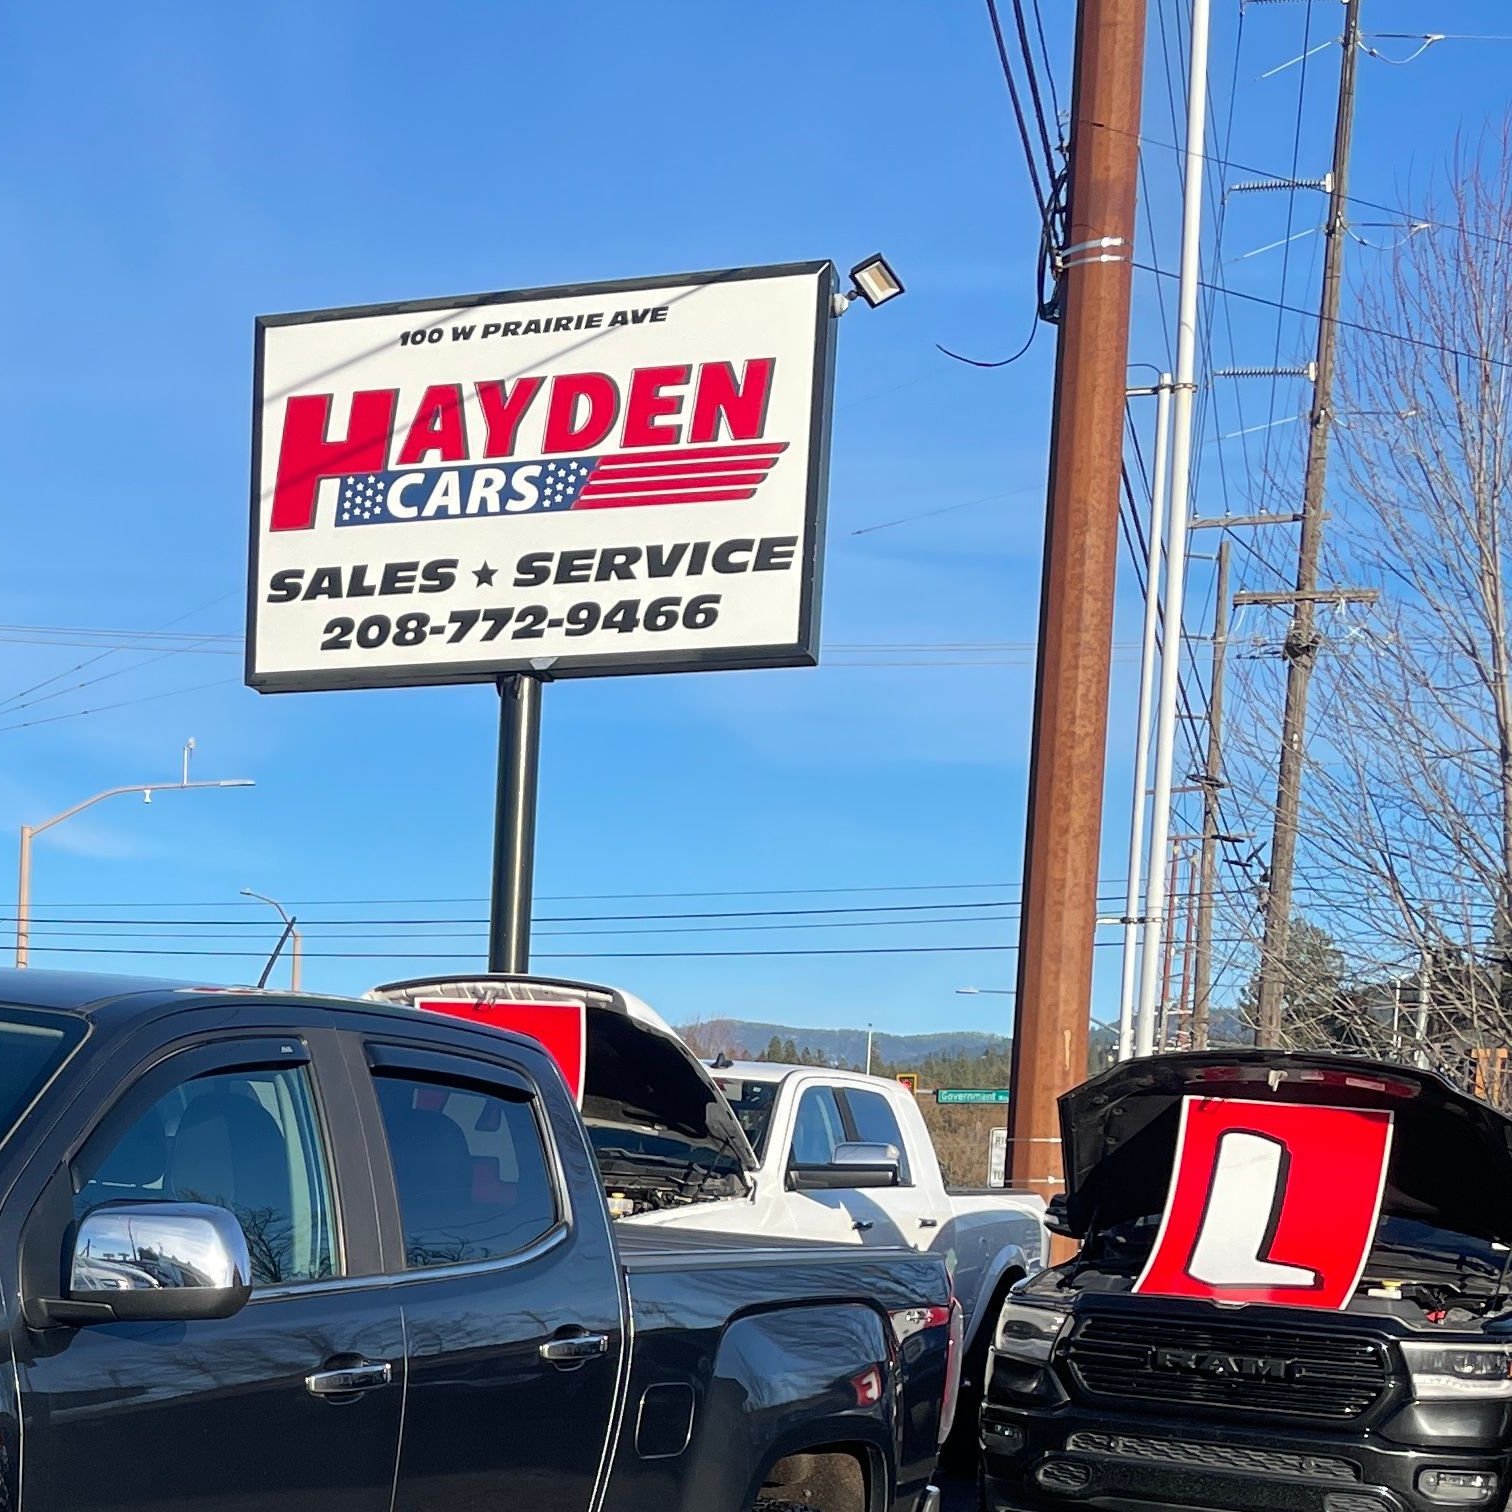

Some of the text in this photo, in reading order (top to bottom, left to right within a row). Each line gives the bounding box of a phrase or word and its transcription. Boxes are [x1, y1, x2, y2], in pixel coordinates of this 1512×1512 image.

[399, 306, 669, 346] 100 W PRAIRIE AVE
[269, 357, 777, 532] HAYDEN
[386, 462, 544, 520] CARS
[266, 535, 799, 603] SALES SERVICE
[319, 593, 722, 651] 208-772-9466
[941, 1091, 996, 1101] Government
[1184, 1129, 1323, 1289] L
[1156, 1349, 1288, 1379] RAM
